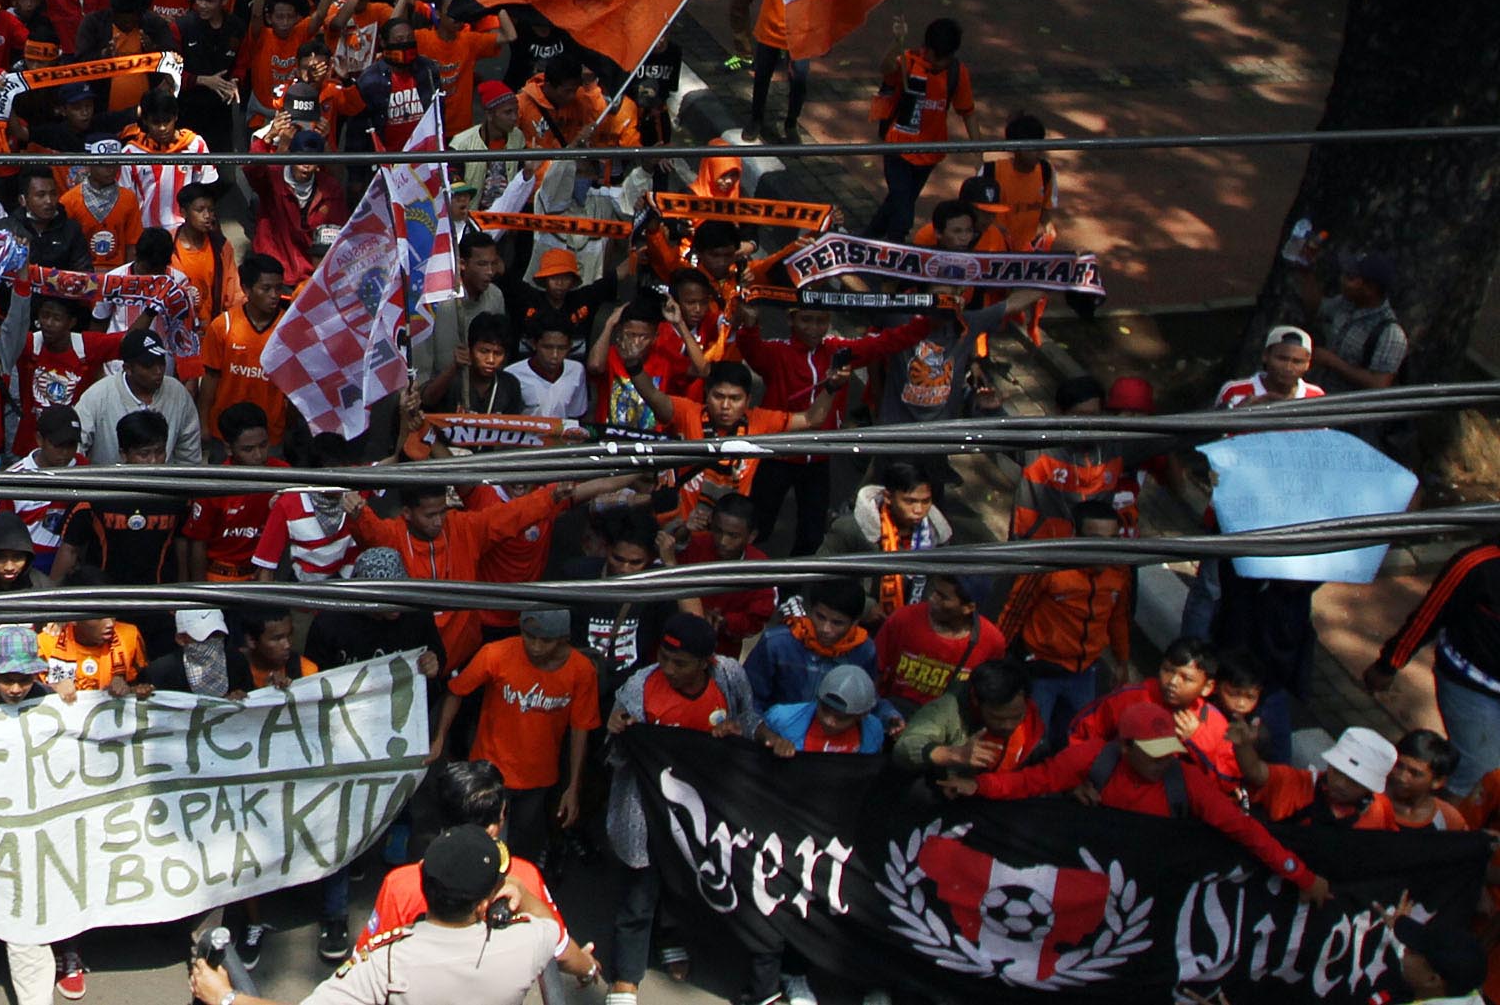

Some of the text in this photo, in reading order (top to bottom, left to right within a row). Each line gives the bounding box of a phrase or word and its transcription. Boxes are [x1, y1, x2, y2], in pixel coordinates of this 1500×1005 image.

[32, 56, 156, 84] PERSIJA
[795, 242, 924, 278] PERSIJA
[107, 841, 266, 906] BOLA
